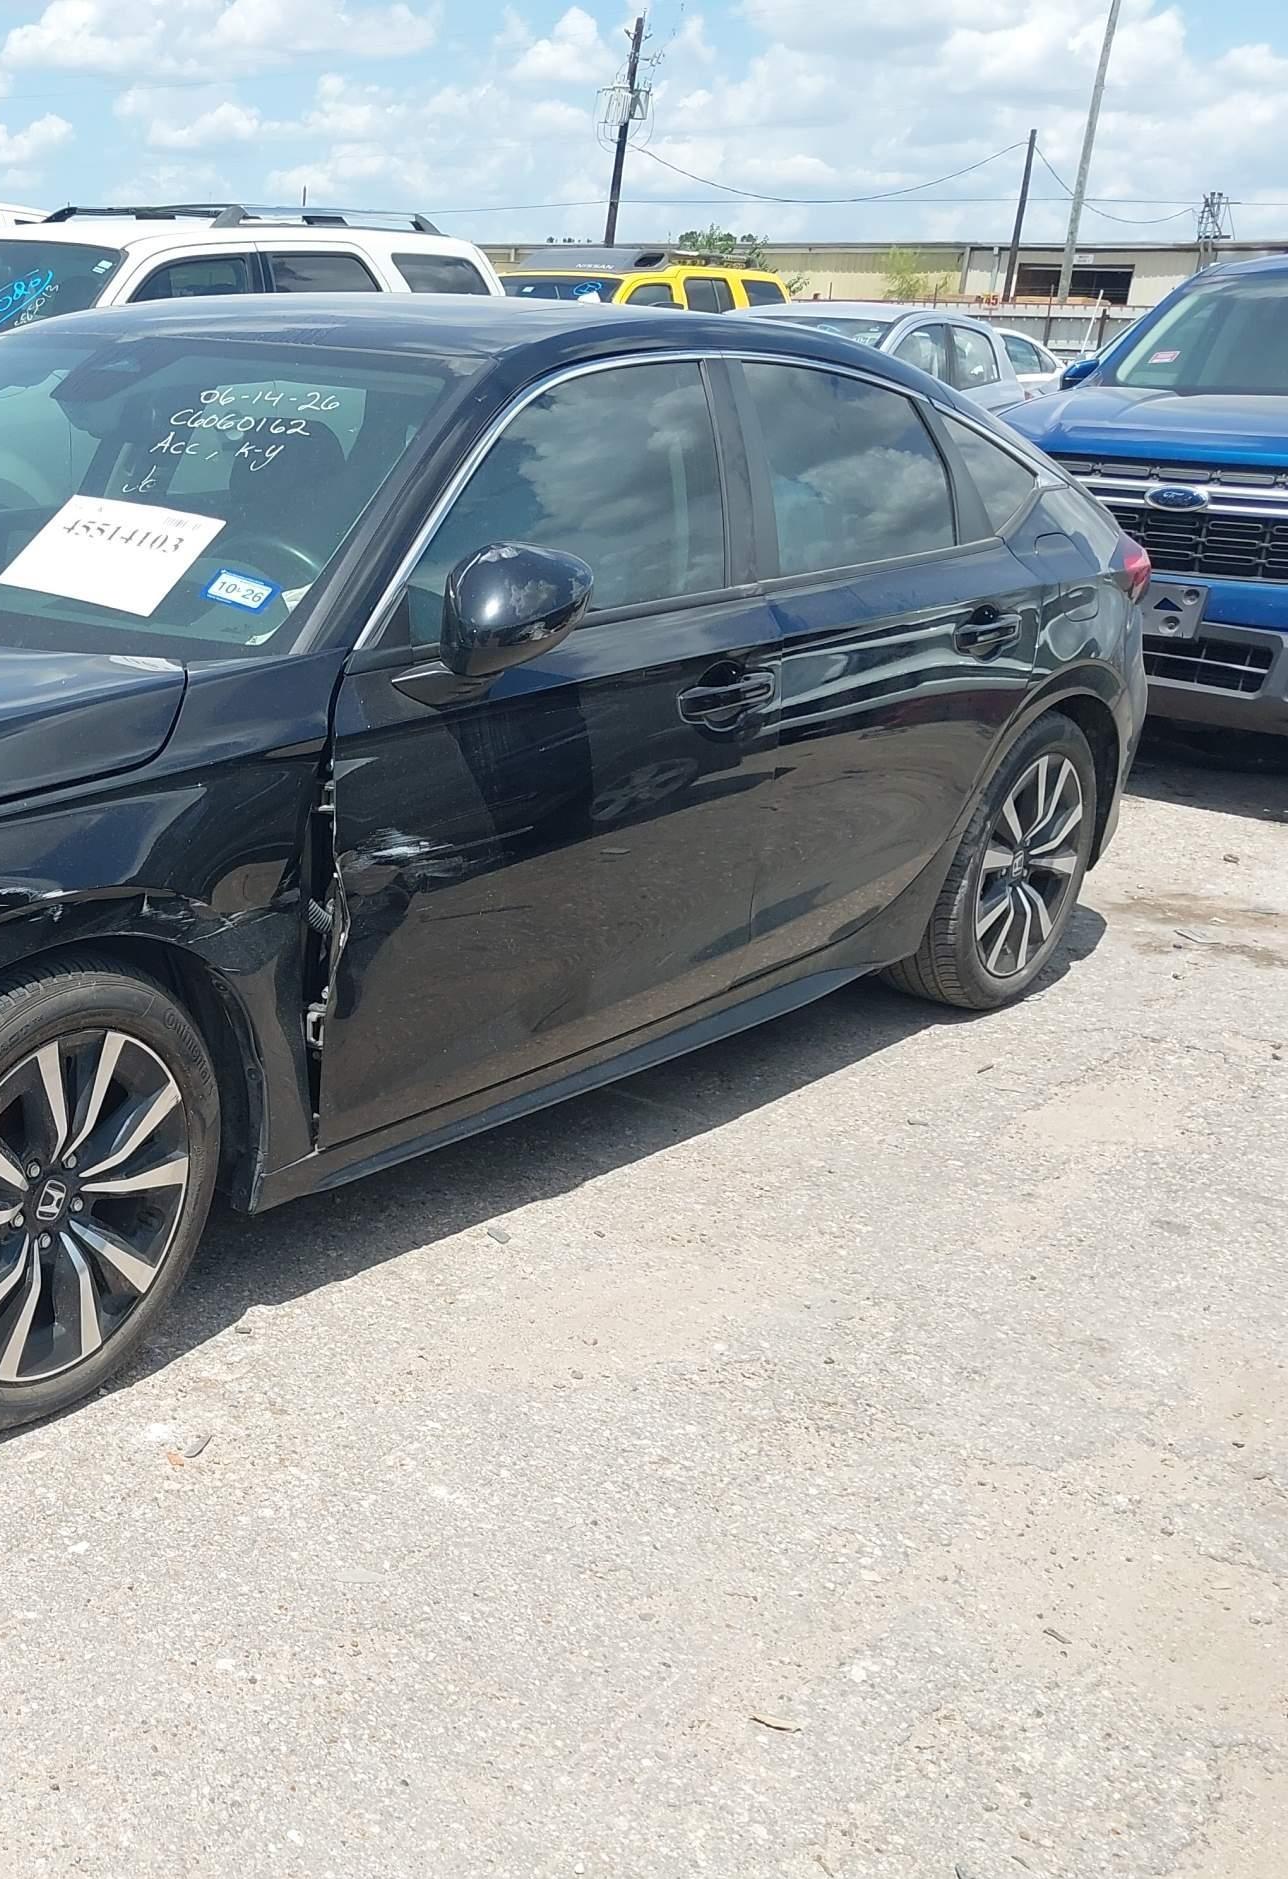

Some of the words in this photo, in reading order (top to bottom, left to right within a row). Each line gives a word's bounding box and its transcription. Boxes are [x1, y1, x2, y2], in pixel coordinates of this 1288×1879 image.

[200, 387, 340, 411] 06-14-26
[169, 408, 311, 437] C6060162
[63, 519, 185, 553] 45514103
[218, 580, 238, 595] 10
[242, 588, 263, 604] 26
